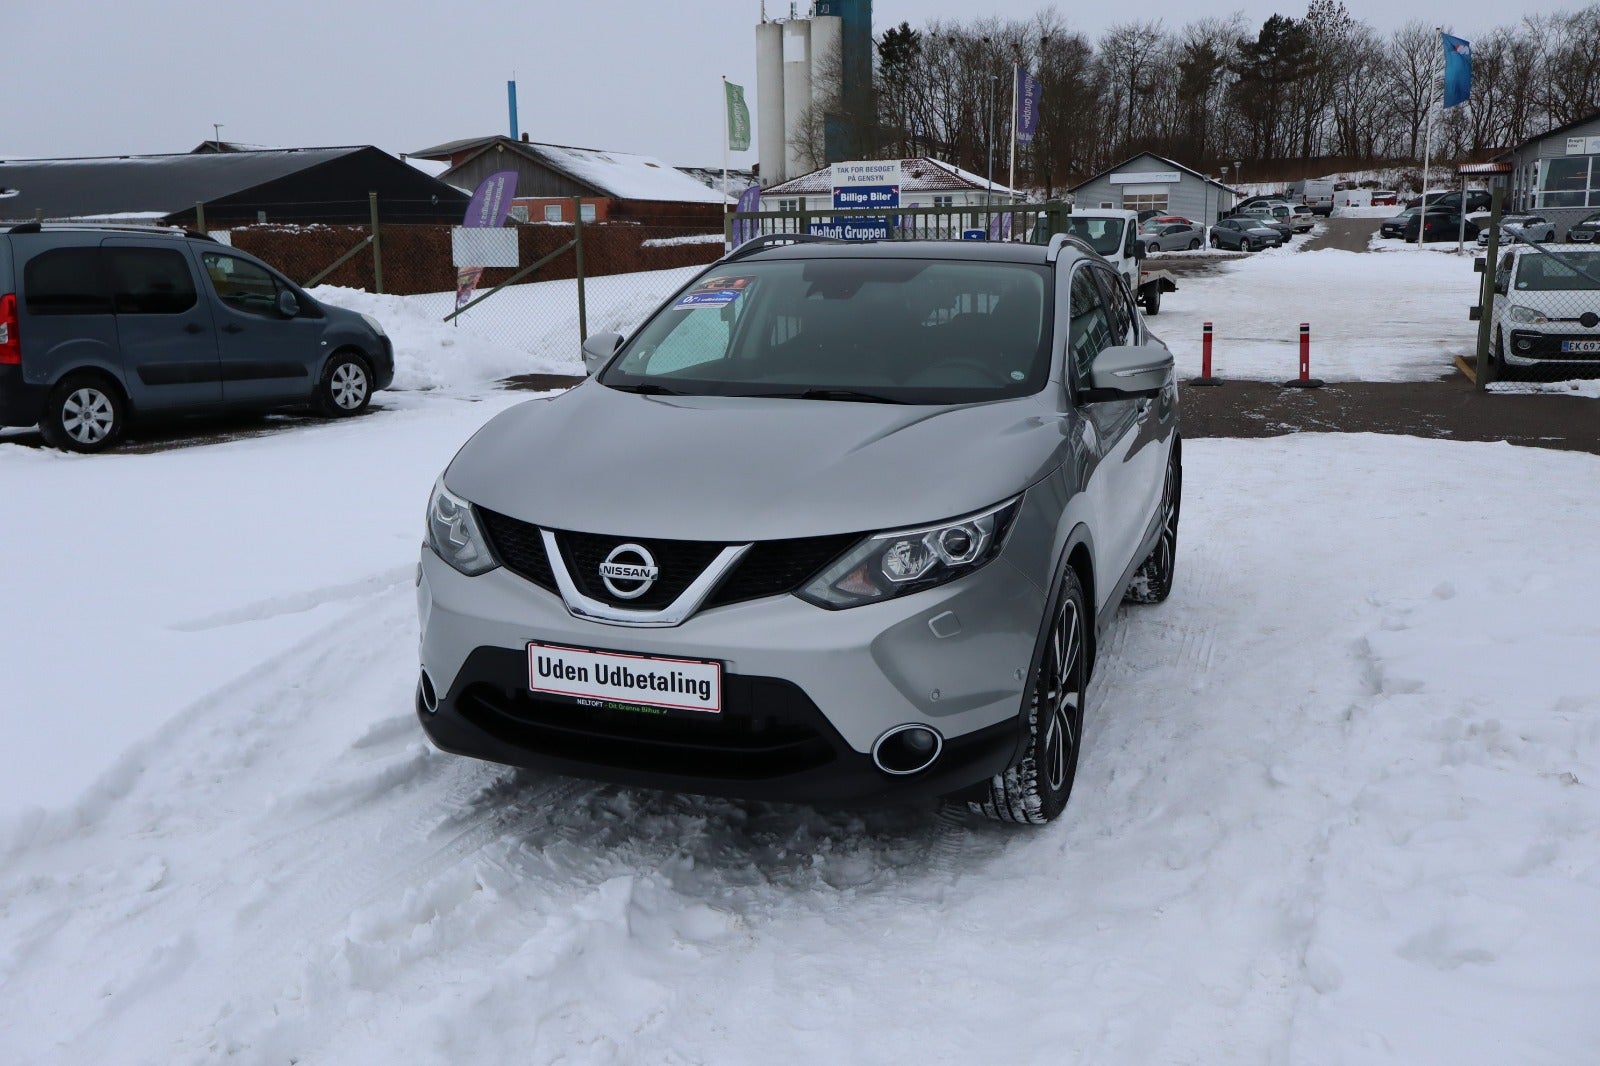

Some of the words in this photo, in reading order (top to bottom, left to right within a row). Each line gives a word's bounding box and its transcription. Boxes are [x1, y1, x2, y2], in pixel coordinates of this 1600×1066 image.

[866, 165, 894, 173] BESØGET
[848, 174, 856, 182] PÅ
[840, 193, 868, 203] Billige
[870, 192, 892, 201] Biler
[810, 225, 843, 239] Neltoft
[845, 225, 886, 240] Gruppen
[1569, 342, 1581, 350] EK
[1583, 342, 1595, 350] 69
[603, 565, 650, 578] NISSAN
[537, 655, 588, 683] Uden
[595, 663, 711, 701] Udbetaling
[576, 698, 603, 707] NELTOFT
[641, 706, 660, 714] Bilhus
